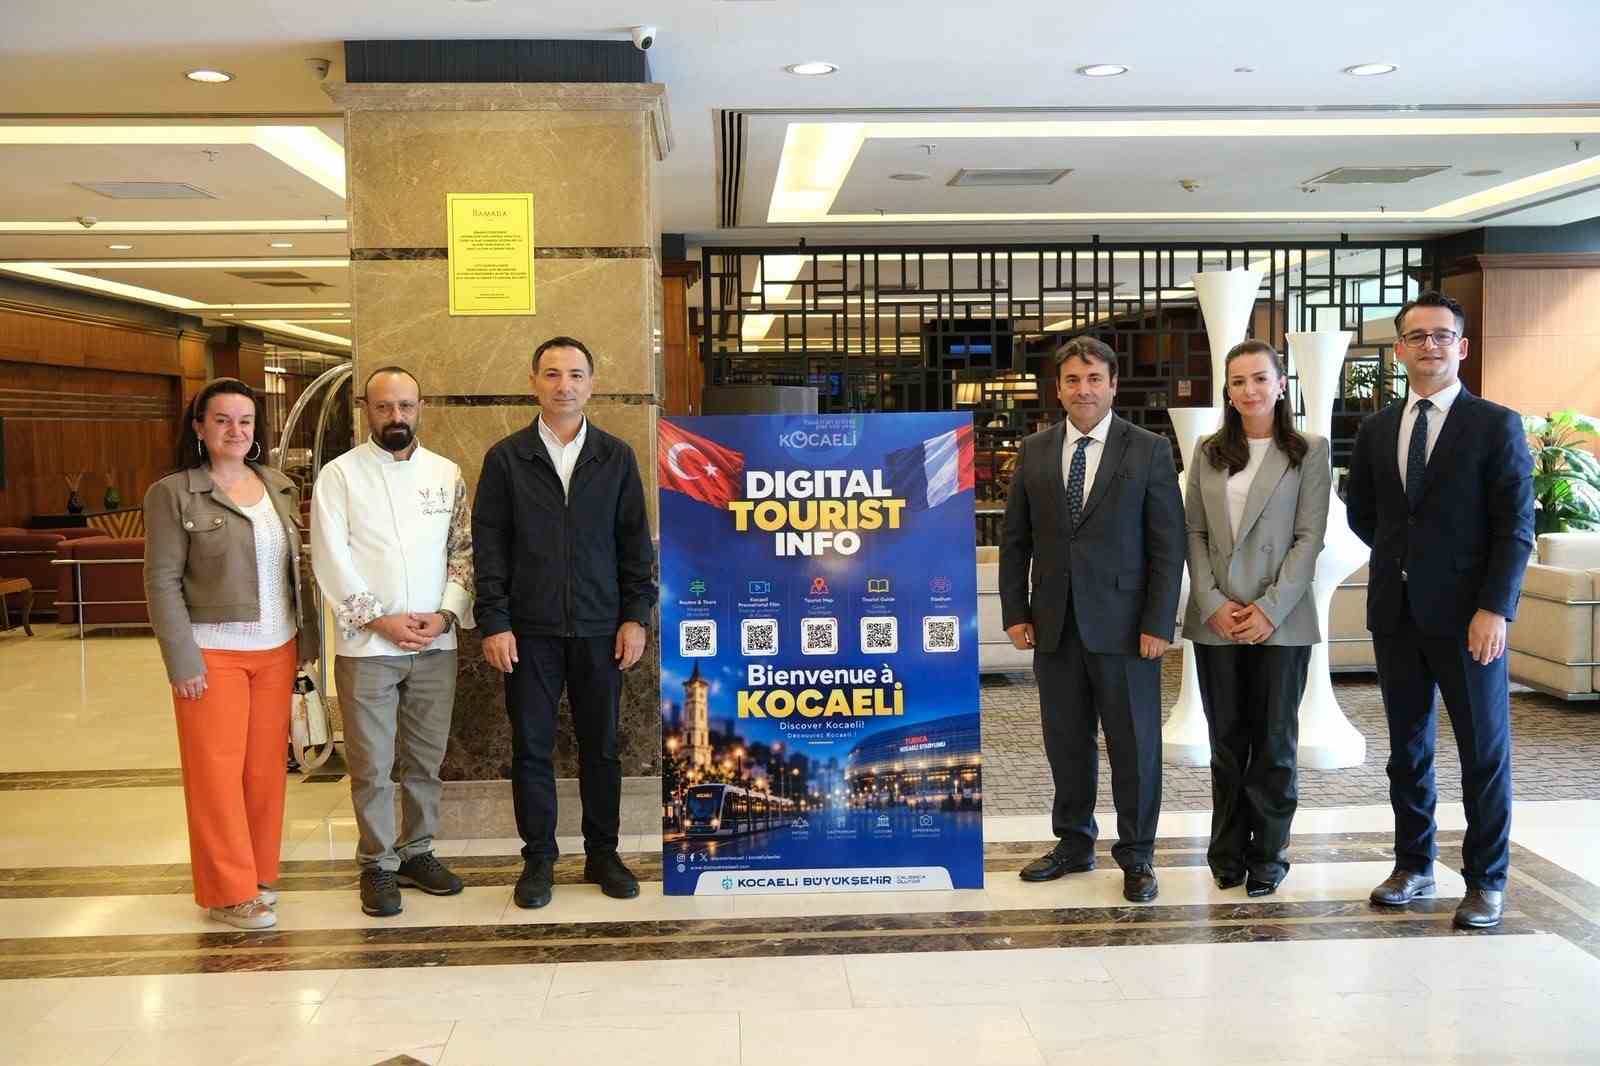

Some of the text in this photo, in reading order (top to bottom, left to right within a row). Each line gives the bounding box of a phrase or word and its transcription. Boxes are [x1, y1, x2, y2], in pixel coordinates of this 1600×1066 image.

[746, 469, 893, 499] DIGITAL
[728, 499, 907, 532] TOURIST
[775, 531, 862, 557] INFO
[748, 663, 894, 686] Bienvenue à
[780, 720, 865, 730] Discover Kocaeli!
